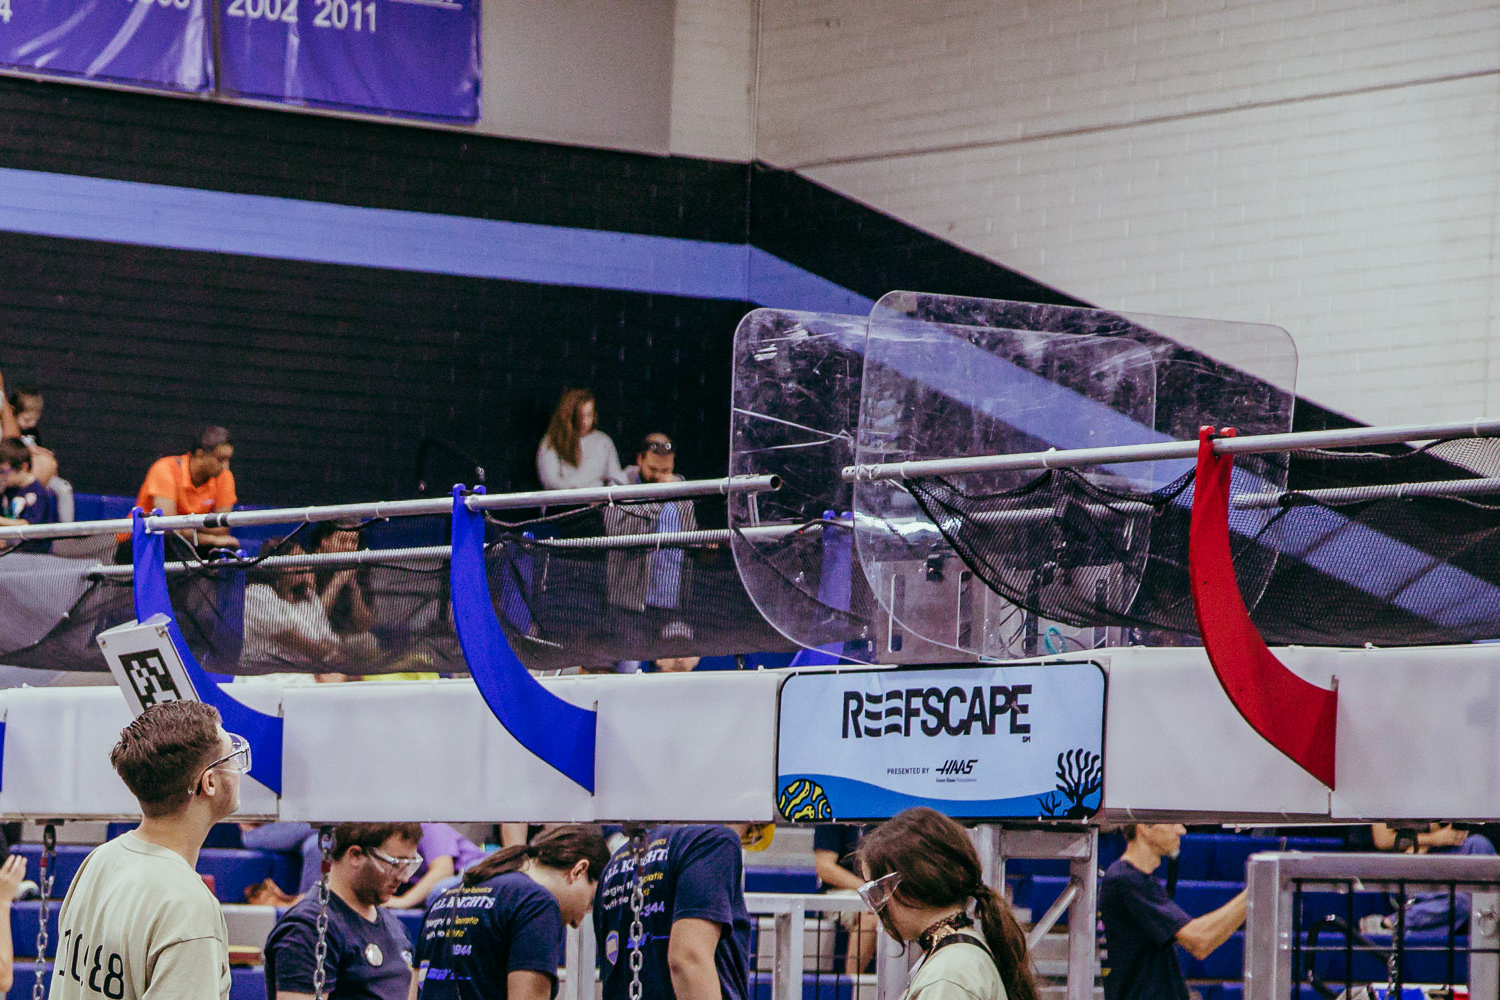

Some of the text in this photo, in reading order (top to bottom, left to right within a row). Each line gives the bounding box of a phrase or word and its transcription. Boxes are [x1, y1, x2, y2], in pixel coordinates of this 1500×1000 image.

[313, 0, 377, 33] 2011
[842, 684, 1033, 738] REEFSCAPE
[886, 767, 920, 775] PRESENTED
[935, 759, 979, 775] HAAS
[59, 929, 124, 1000] 1088
